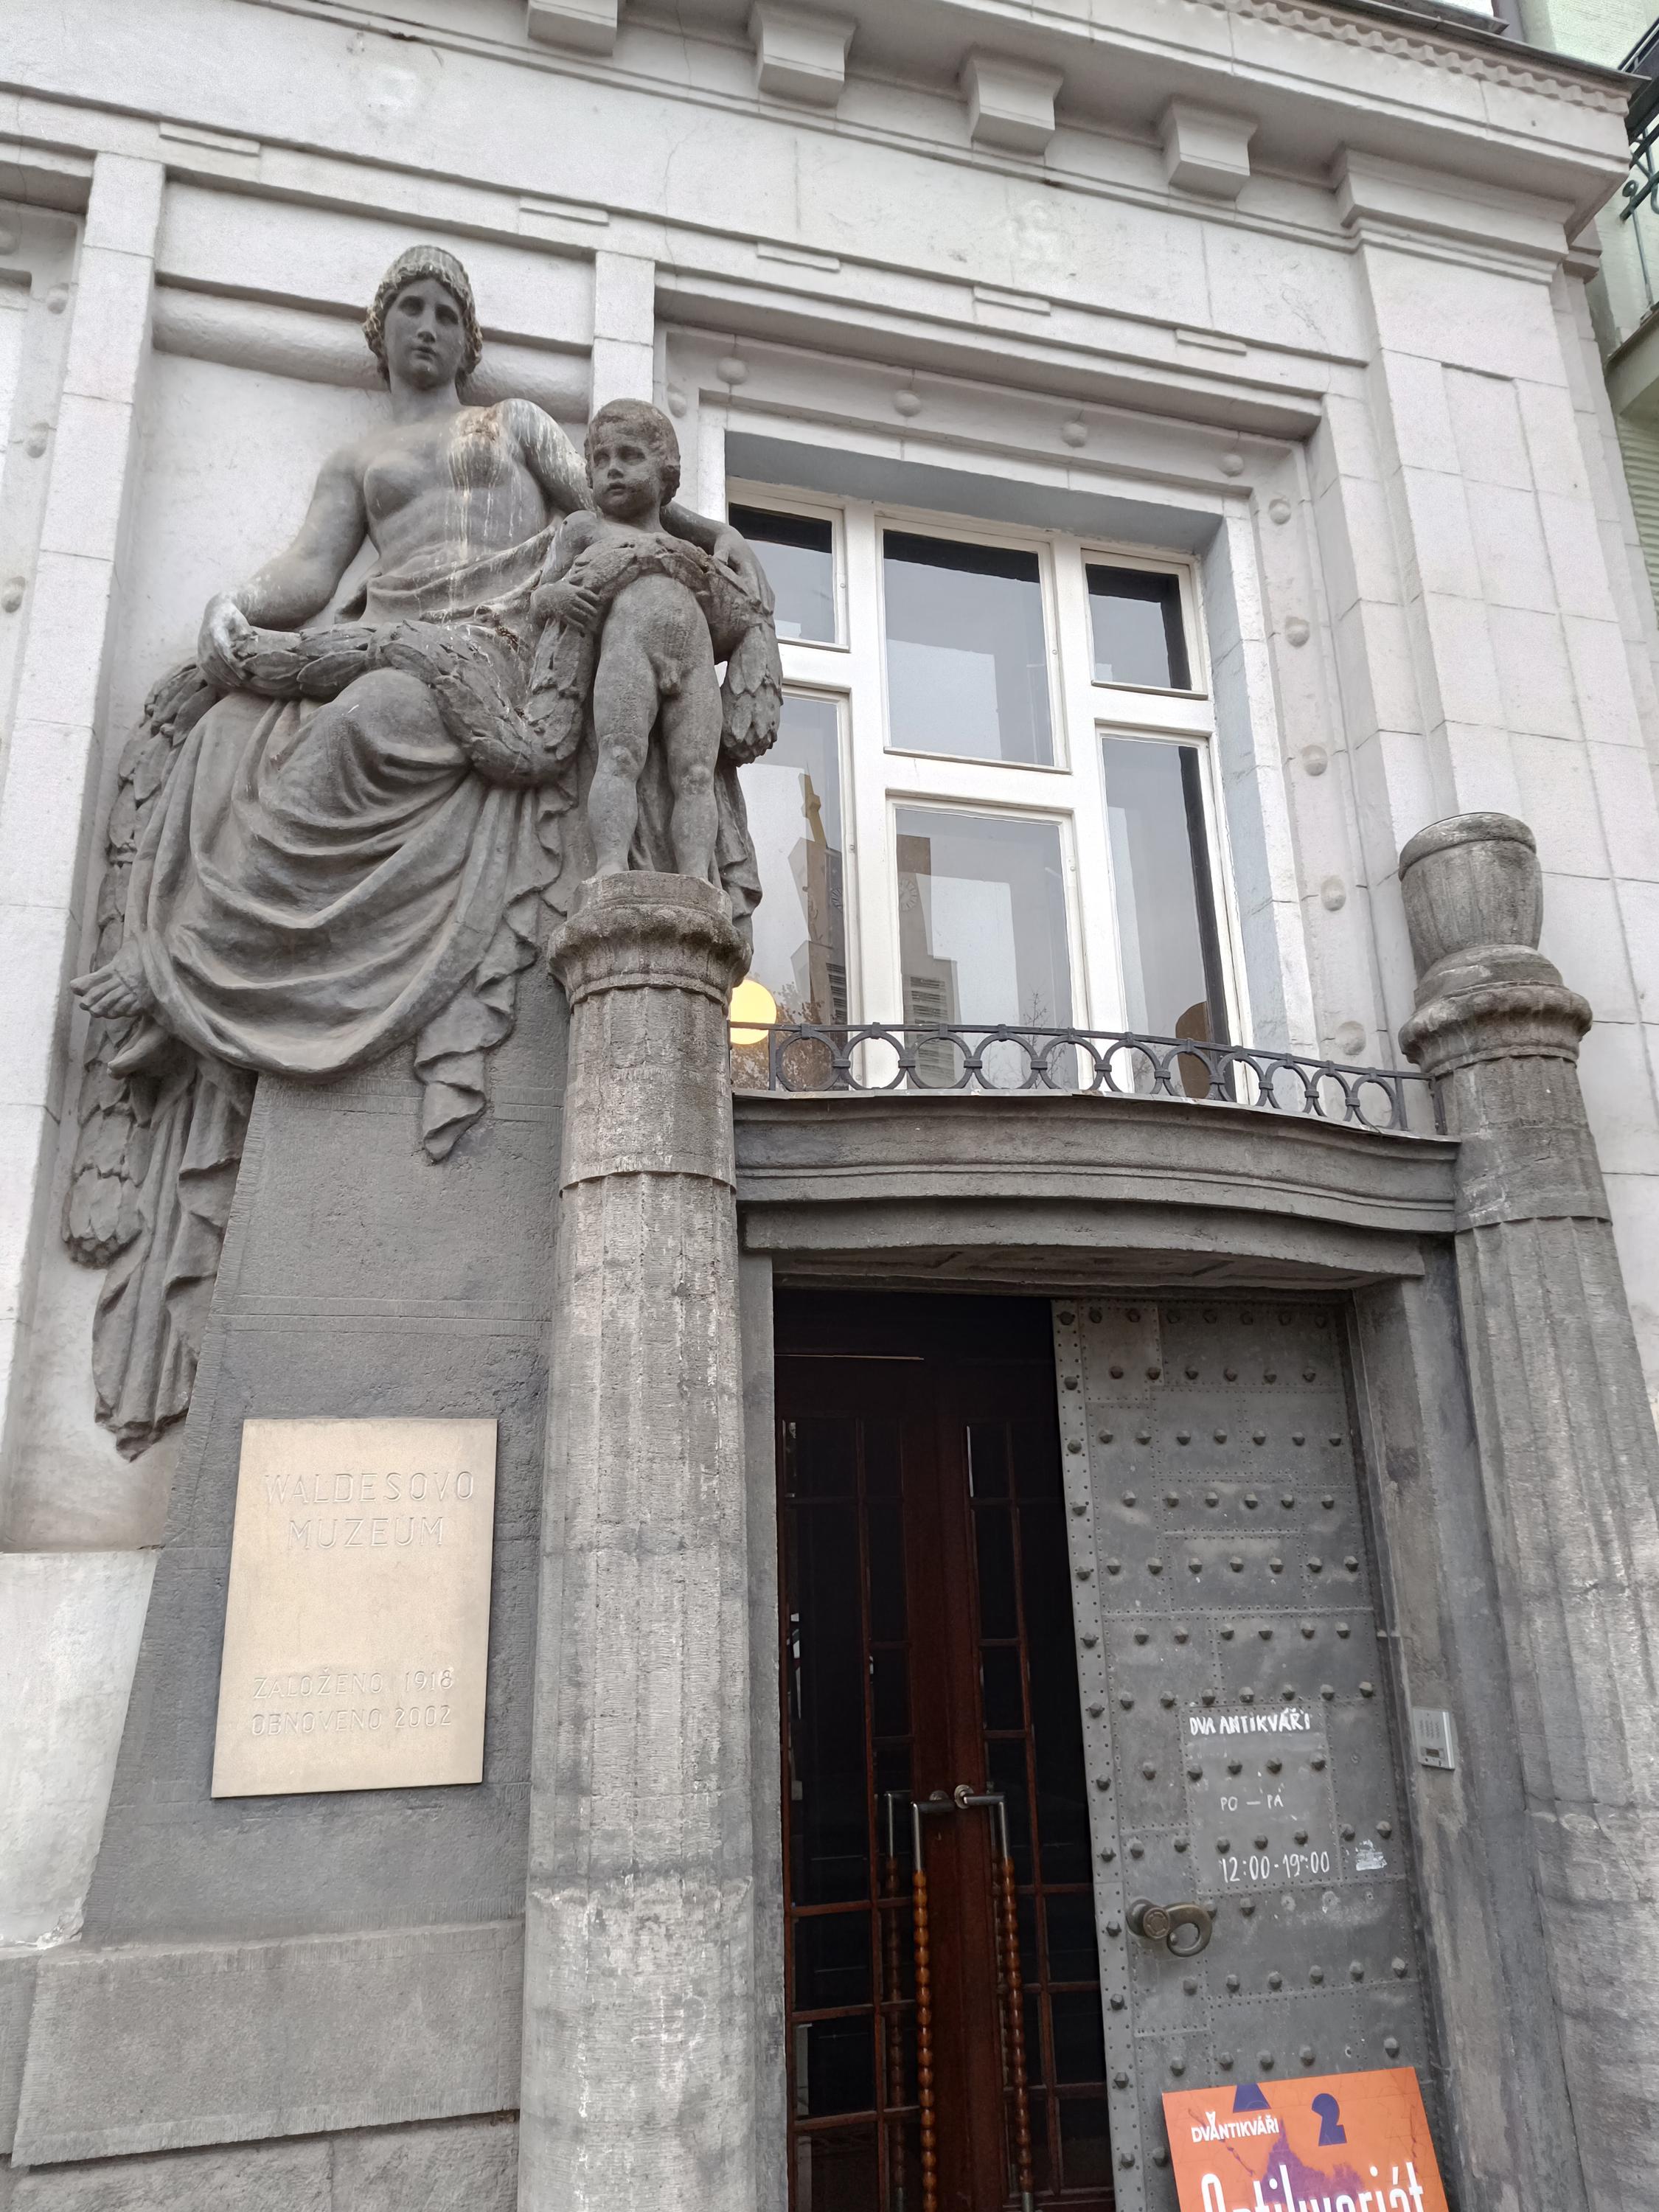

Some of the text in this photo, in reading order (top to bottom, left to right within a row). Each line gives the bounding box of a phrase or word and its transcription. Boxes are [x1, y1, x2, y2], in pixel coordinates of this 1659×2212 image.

[265, 1471, 473, 1504] WALDESOVO
[288, 1516, 443, 1549] MUZEUM
[254, 1667, 454, 1699] ZALOŽENO 1918
[251, 1704, 452, 1736] OBNOVENO 2002
[1189, 1717, 1216, 1735] DVA
[1220, 1796, 1238, 1811] PO
